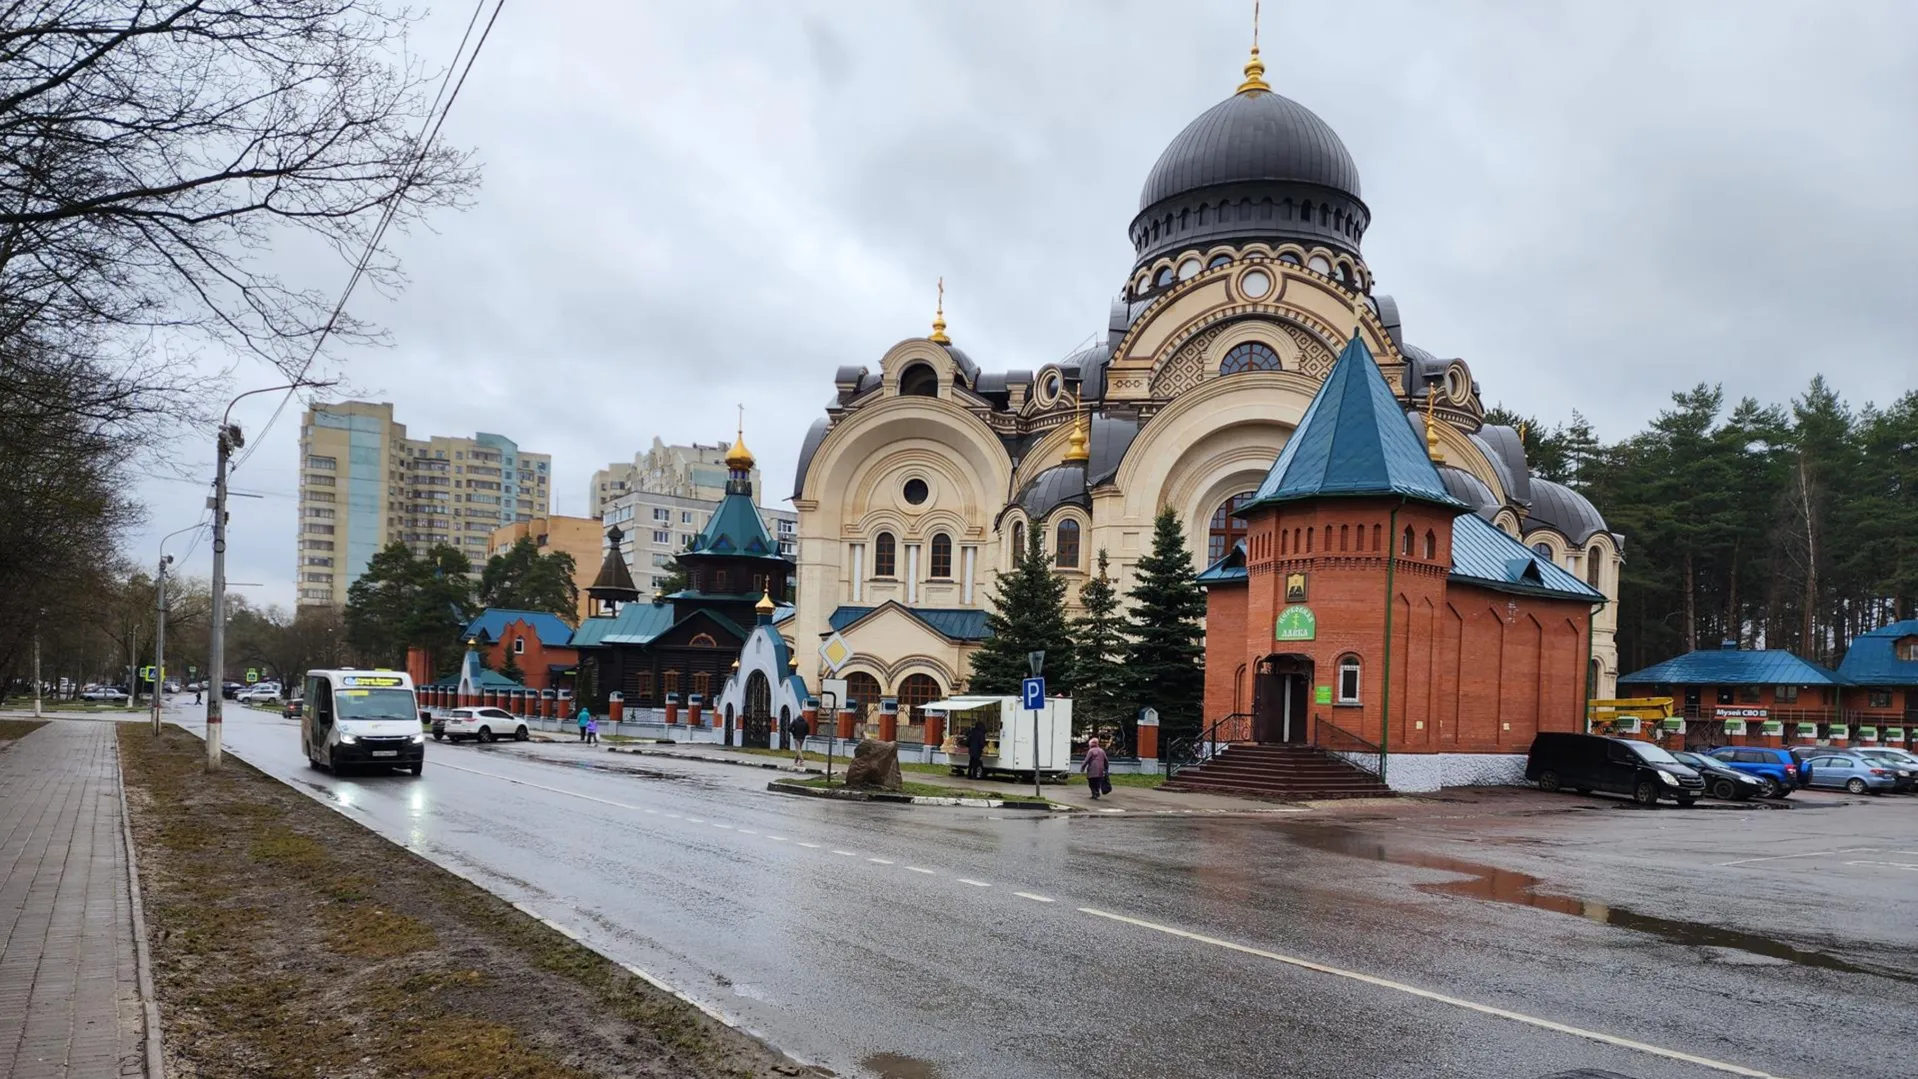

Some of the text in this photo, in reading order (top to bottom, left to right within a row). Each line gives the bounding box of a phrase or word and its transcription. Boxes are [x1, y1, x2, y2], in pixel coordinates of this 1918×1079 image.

[1281, 629, 1308, 637] ЛАВКА
[1027, 681, 1040, 707] P
[1716, 708, 1759, 717] Музей СВО
